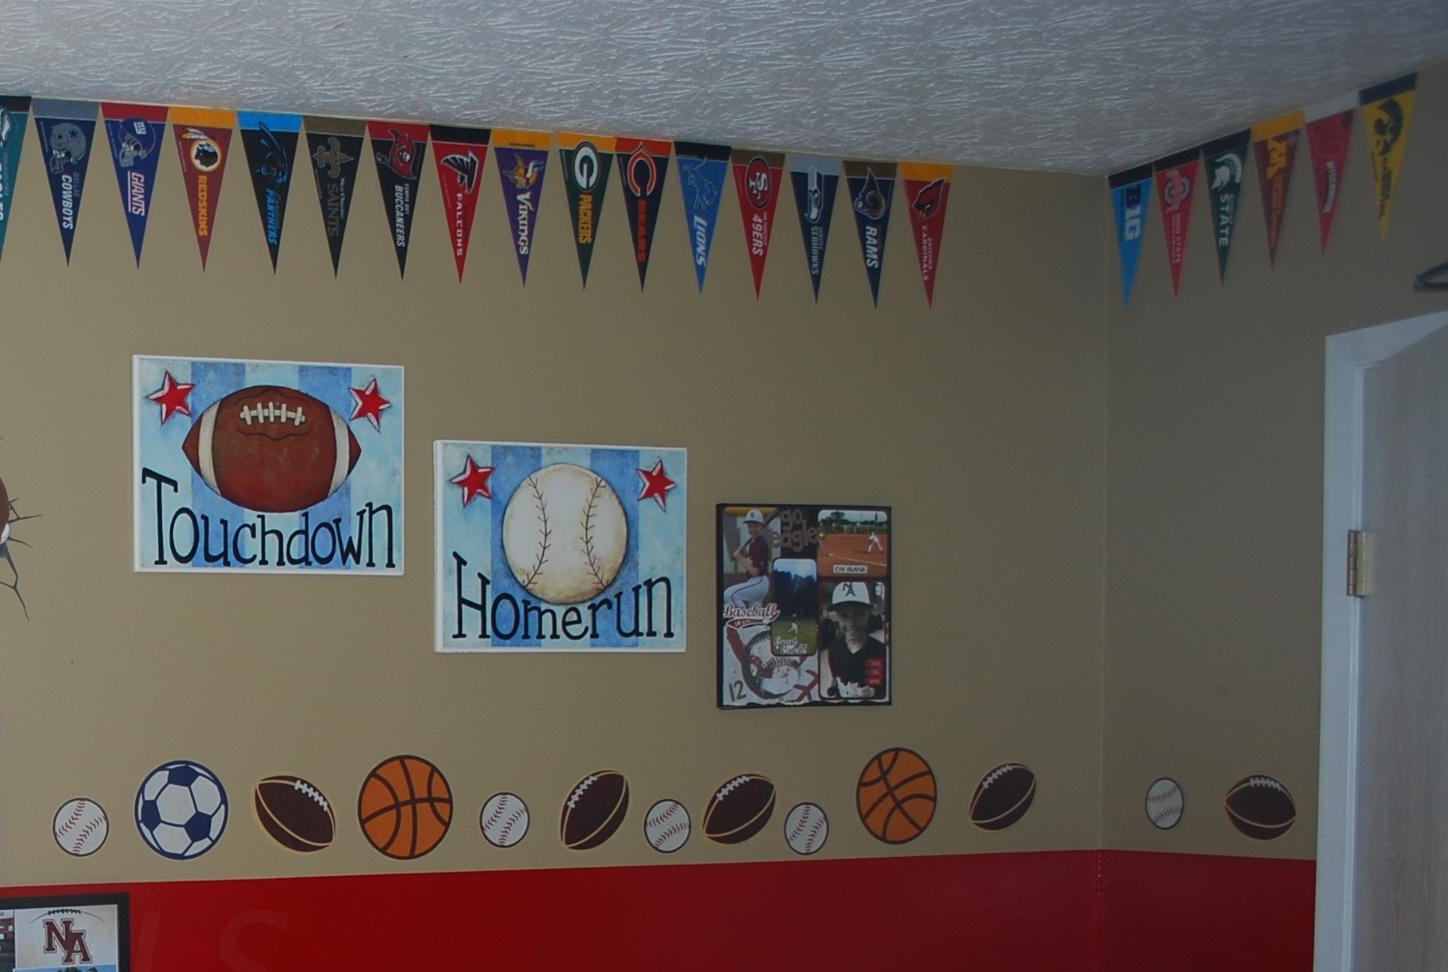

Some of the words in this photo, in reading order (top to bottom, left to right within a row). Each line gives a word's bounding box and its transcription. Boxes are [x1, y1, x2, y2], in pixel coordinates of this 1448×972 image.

[61, 174, 74, 231] COWBOYS
[131, 171, 145, 217] GIANTS
[198, 175, 208, 237] REDSKINS
[265, 189, 277, 246] PANTHERS
[327, 184, 339, 237] SAINTS
[394, 185, 405, 248] BUCCANEERS
[579, 194, 592, 245] PACKERS
[1219, 193, 1230, 247] STATE
[638, 200, 647, 264] BEARS
[693, 214, 708, 267] LIONS
[752, 214, 763, 257] 49ERS
[811, 226, 819, 276] SEAHAWKS
[865, 225, 879, 269] RAMS
[140, 467, 396, 569] Touchdown
[451, 551, 675, 642] Homerun
[722, 602, 781, 620] Baseball
[728, 680, 747, 702] 12
[43, 918, 93, 965] NA
